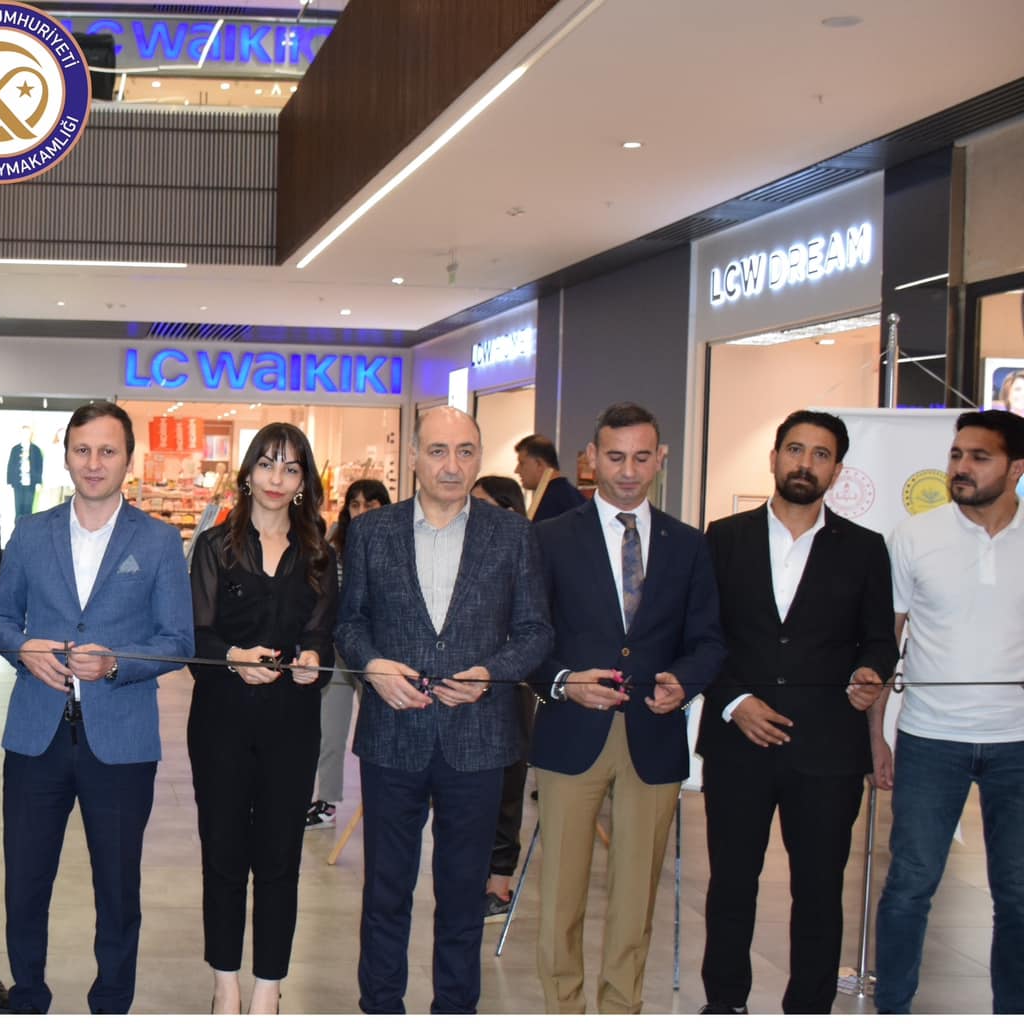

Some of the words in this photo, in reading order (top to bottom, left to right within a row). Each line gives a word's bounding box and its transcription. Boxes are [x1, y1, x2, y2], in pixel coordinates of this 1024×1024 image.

[710, 252, 766, 304] LCW
[769, 223, 872, 289] DREAM
[126, 348, 189, 388] LC
